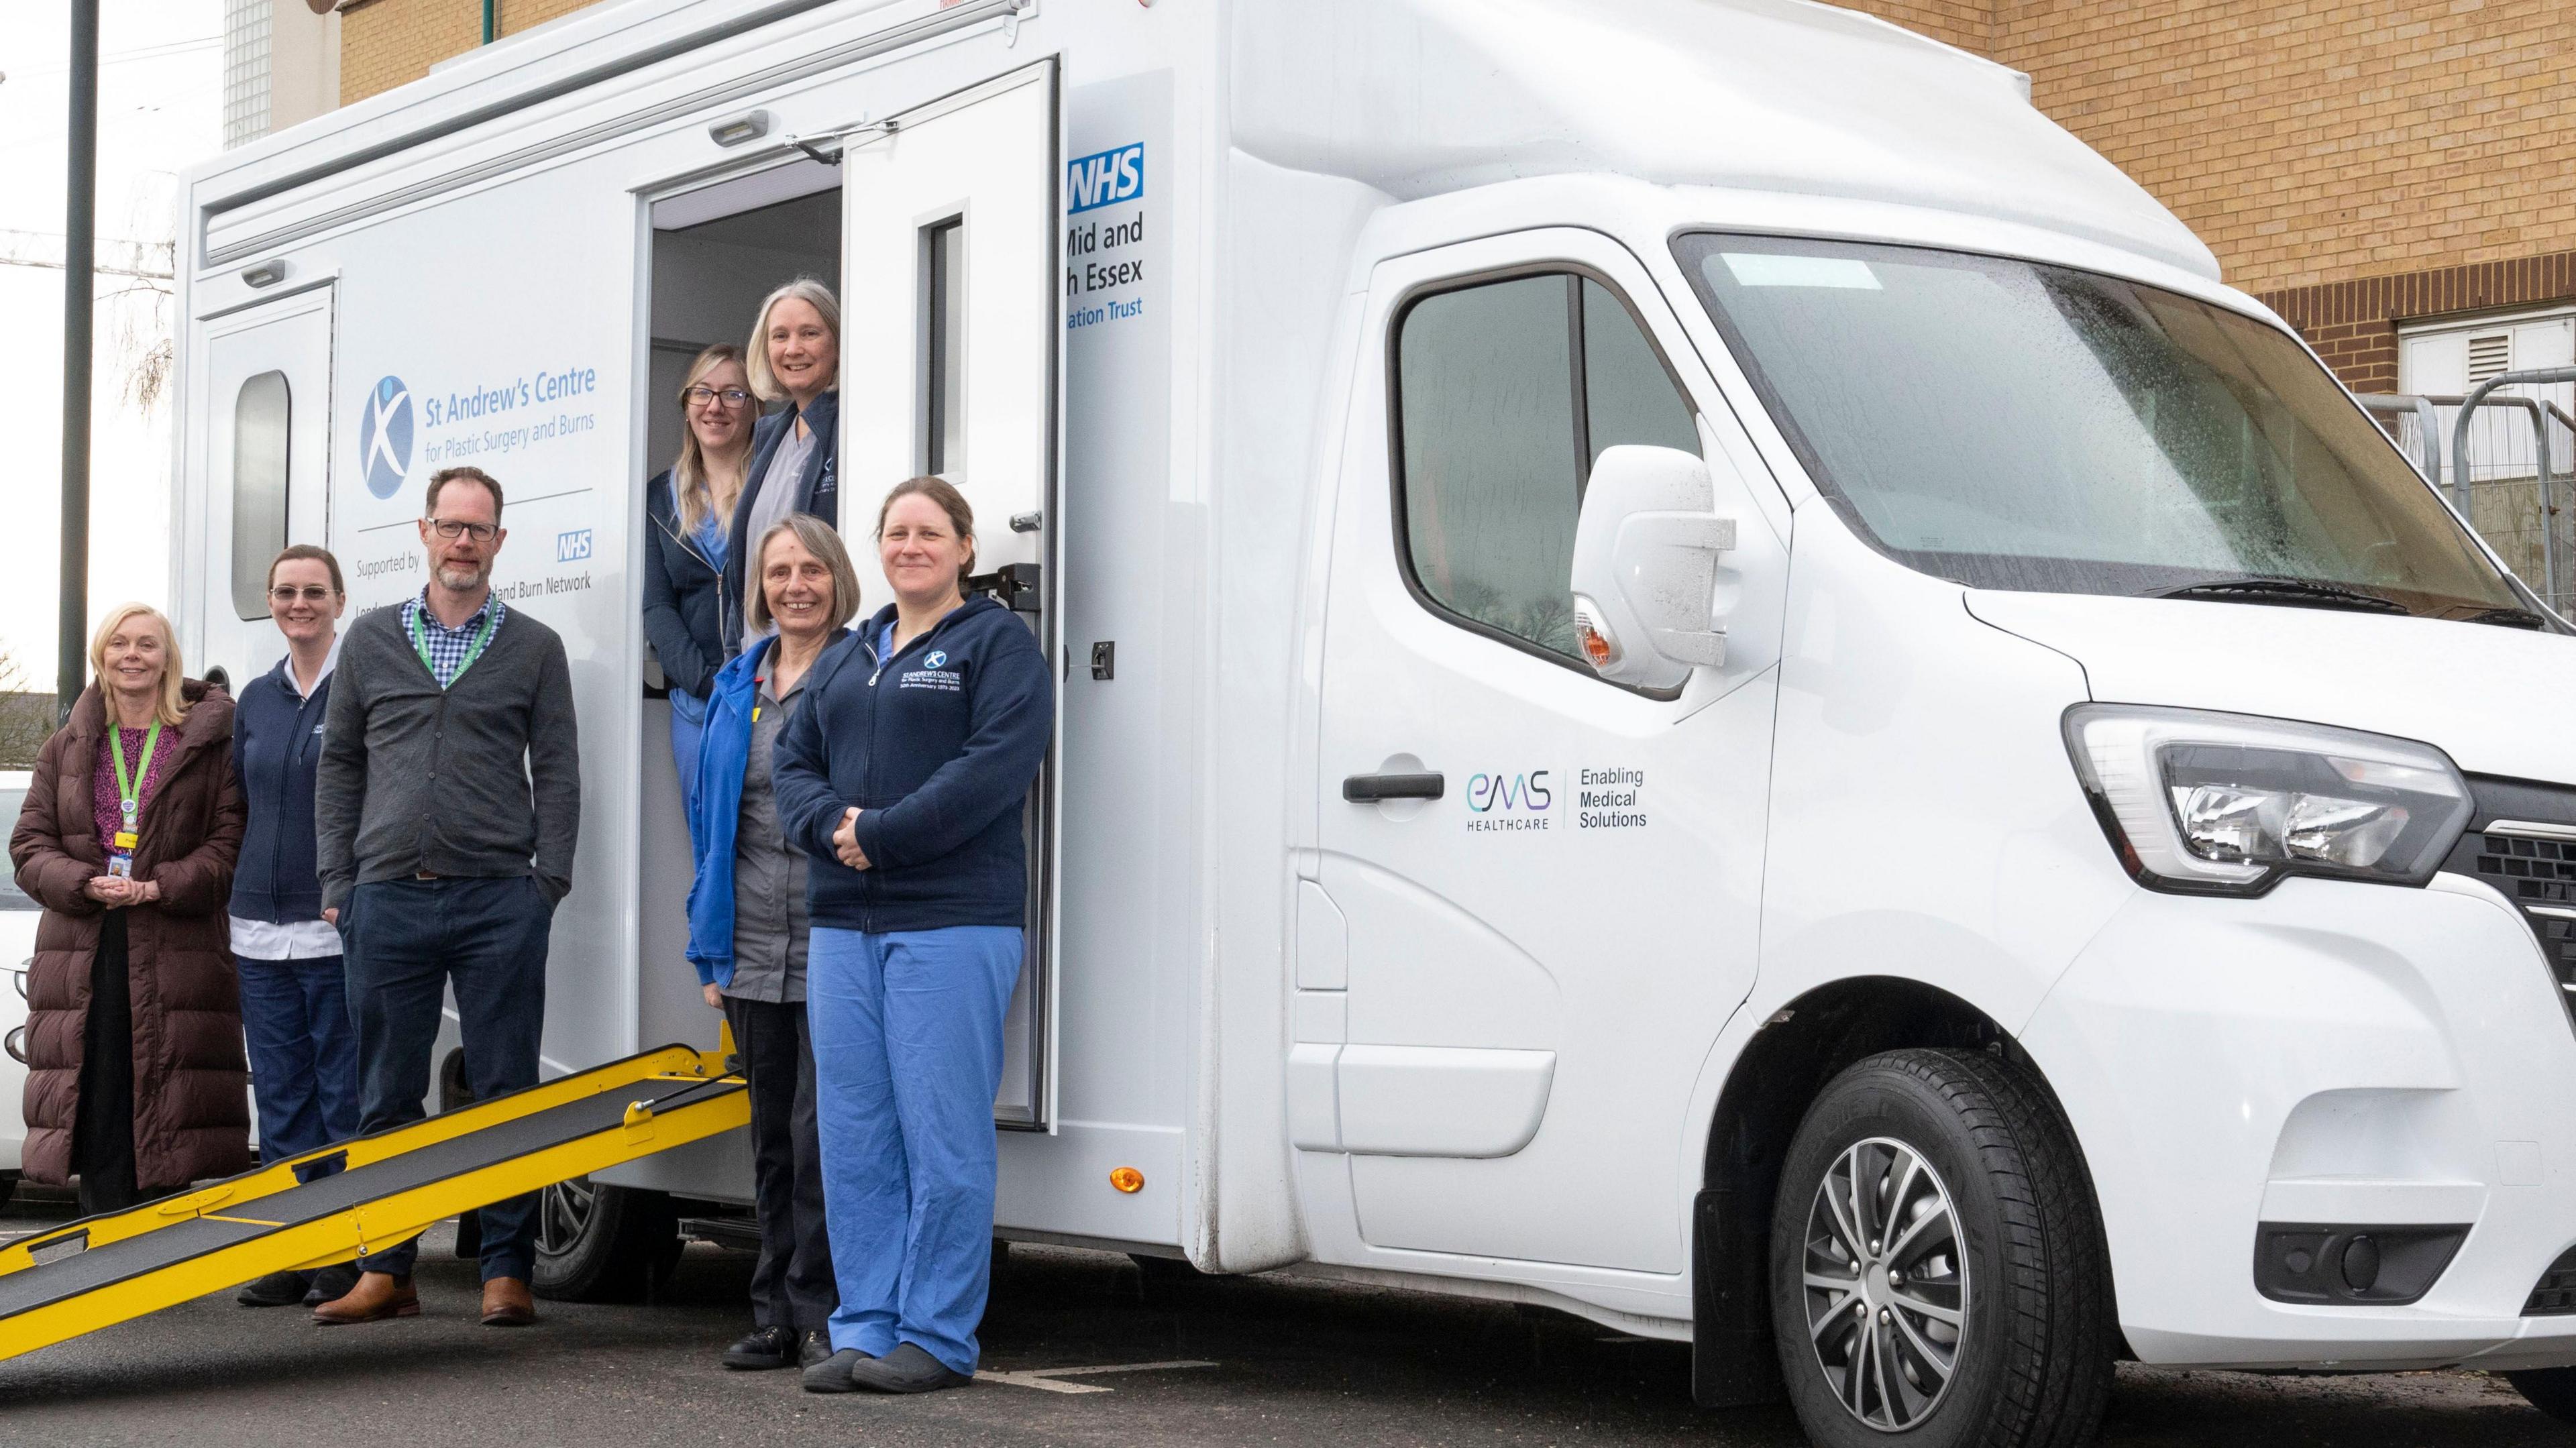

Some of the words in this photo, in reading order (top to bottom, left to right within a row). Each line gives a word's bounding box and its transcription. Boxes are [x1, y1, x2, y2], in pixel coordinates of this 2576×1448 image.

[1067, 147, 1141, 210] NHS
[1104, 211, 1143, 249] and
[1087, 260, 1143, 292] Essex
[1067, 307, 1104, 329] ation
[1108, 297, 1142, 321] Trust
[426, 398, 441, 428] St
[446, 378, 529, 423] Andrew's
[535, 367, 596, 403] Centre
[425, 442, 442, 463] for
[445, 433, 480, 459] Plastic
[484, 426, 529, 453] Surgery
[533, 415, 555, 441] and
[560, 413, 594, 435] Burns
[558, 531, 591, 561] NHS
[357, 551, 405, 580] Supported
[409, 550, 420, 573] by
[495, 581, 516, 601] land
[519, 581, 543, 598] Burn
[546, 570, 591, 595] Network
[1580, 767, 1644, 787] Enabling
[1580, 789, 1636, 807] Medical
[1467, 818, 1549, 832] HEALTHCARE
[1580, 811, 1647, 828] Solutions
